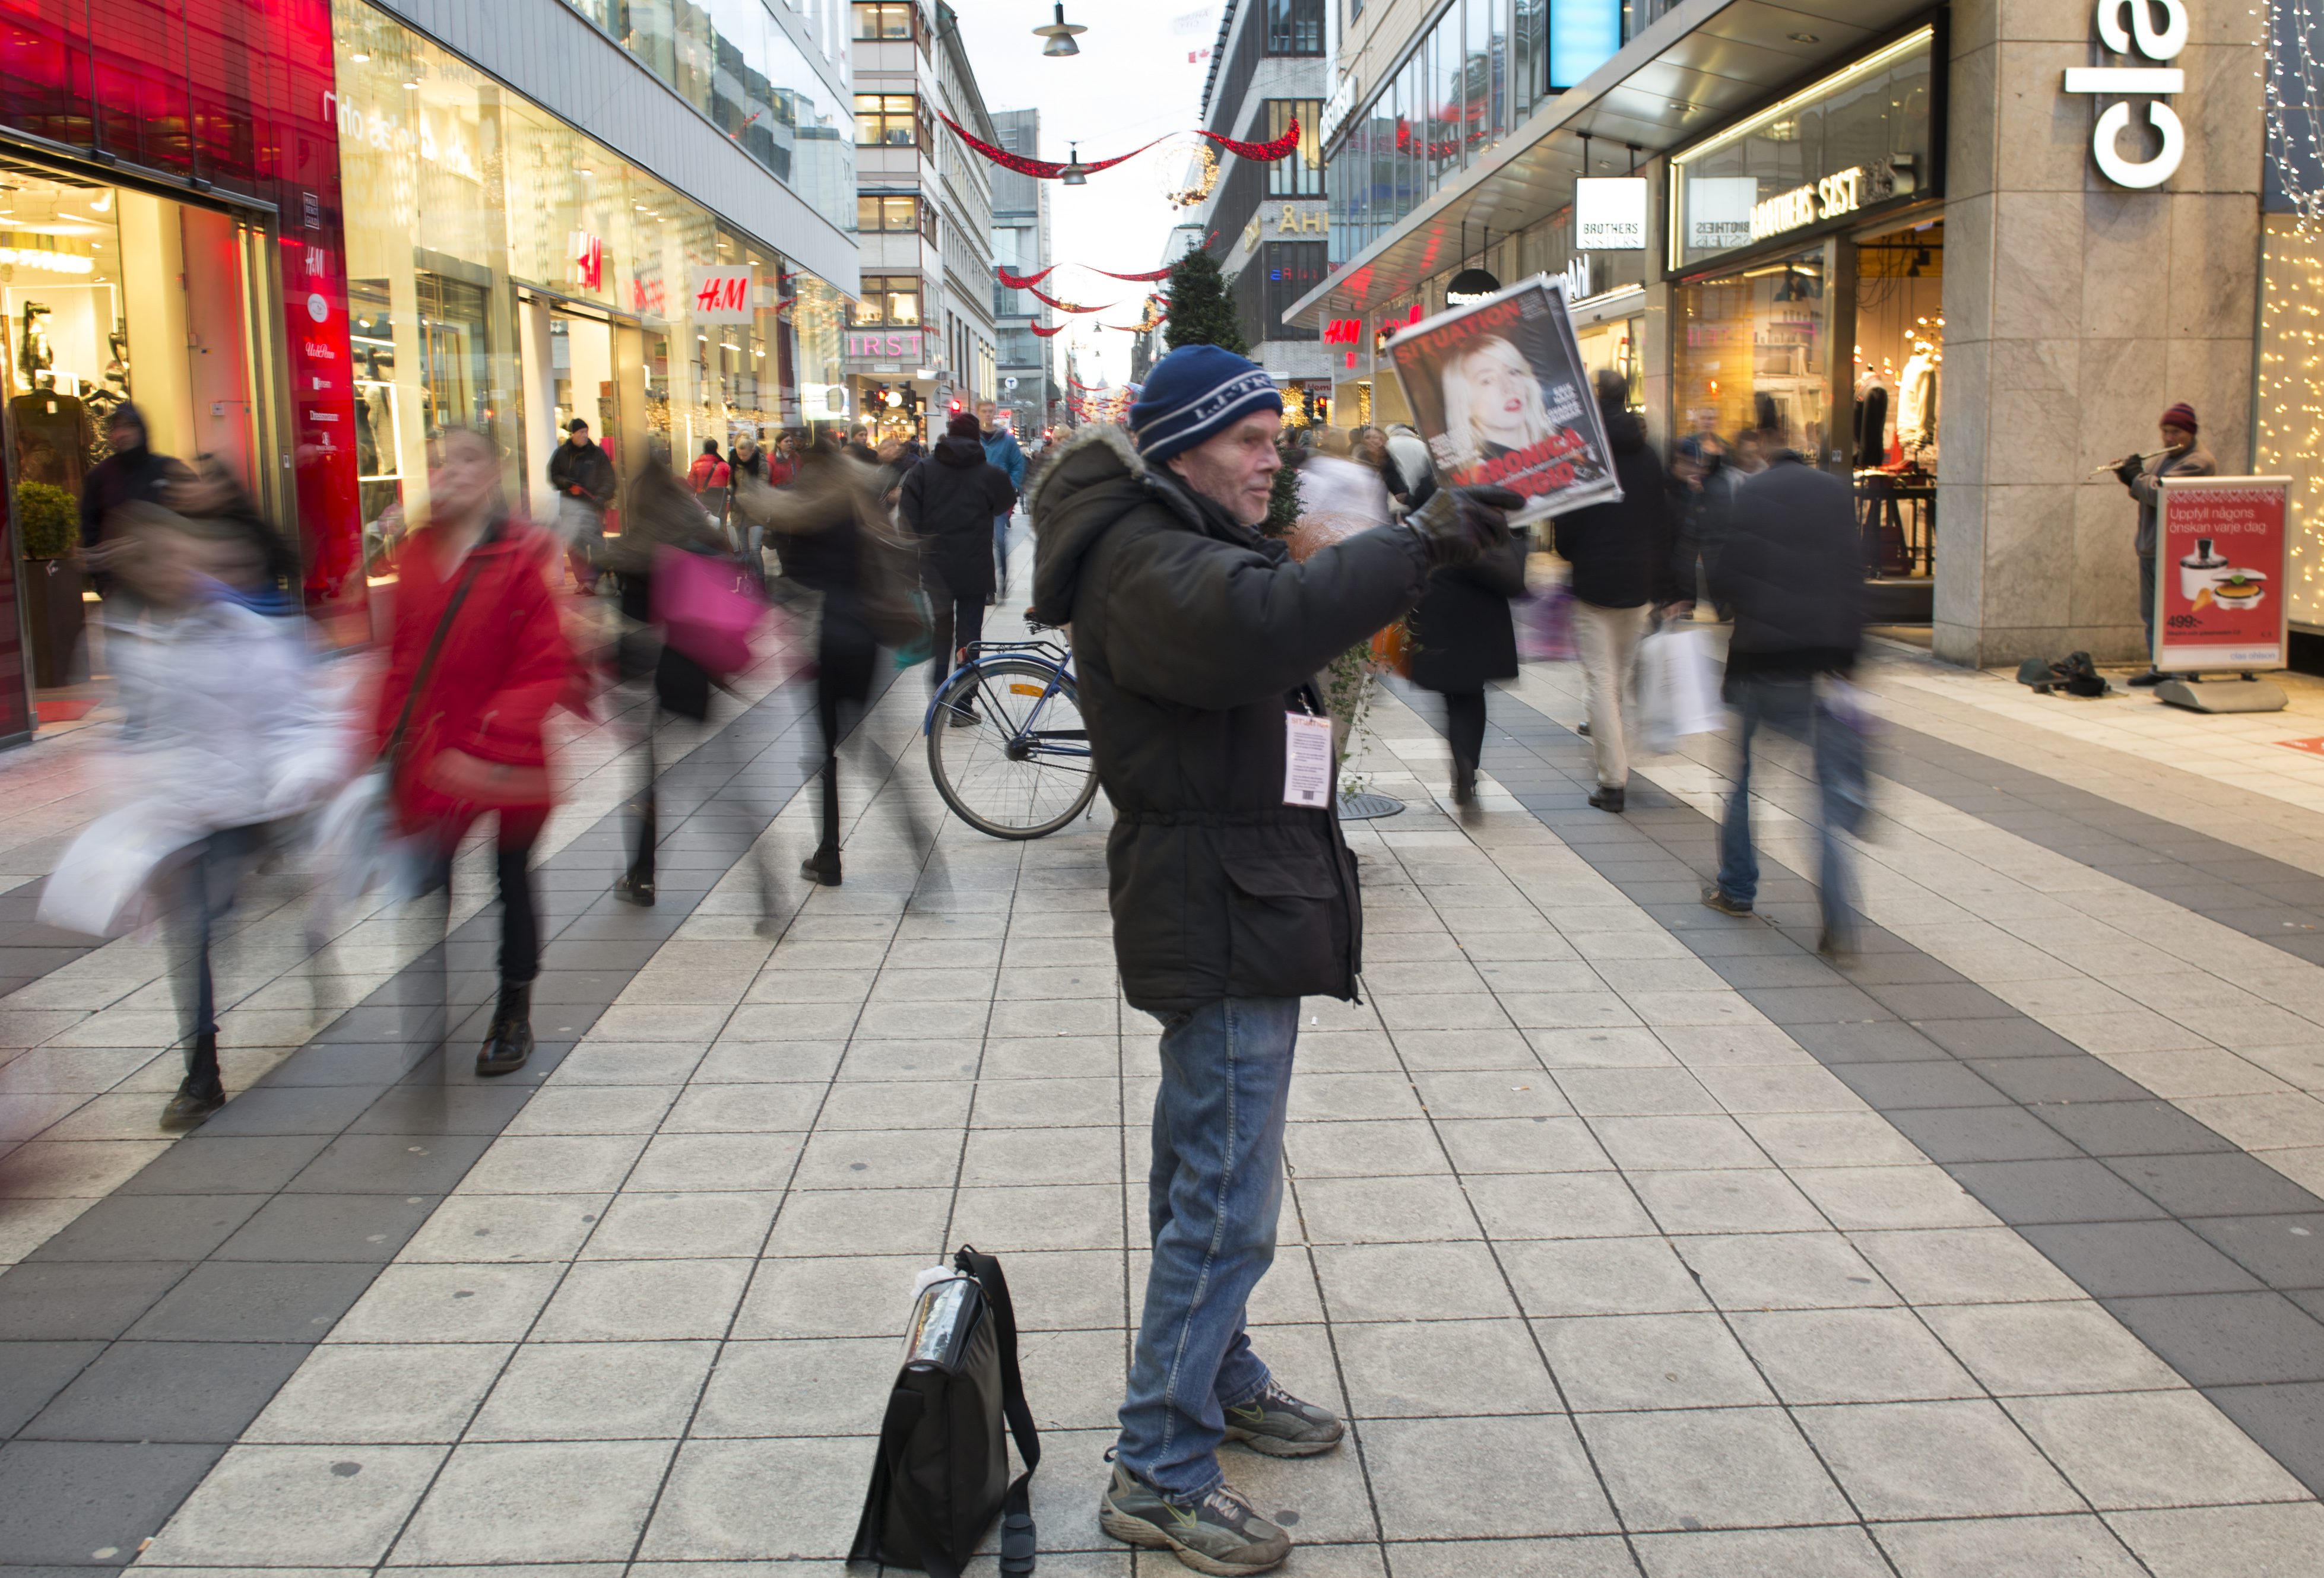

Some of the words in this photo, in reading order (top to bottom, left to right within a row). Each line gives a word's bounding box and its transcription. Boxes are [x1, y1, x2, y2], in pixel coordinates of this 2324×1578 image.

[1751, 182, 1815, 241] BROTHERS
[1583, 223, 1638, 234] BROTHERS
[1584, 236, 1638, 248] SISTERS
[696, 277, 747, 312] H&M
[1324, 319, 1361, 345] H&M
[1396, 298, 1523, 366] SITUATION
[1452, 427, 1586, 485] VERONICA
[2170, 508, 2208, 520] Uppfyll
[2212, 506, 2254, 520] någons
[2170, 522, 2210, 533] önskan
[2214, 523, 2240, 534] varje
[2244, 521, 2266, 535] dag
[2167, 615, 2203, 628] 499:-
[2250, 651, 2275, 659] ohlson
